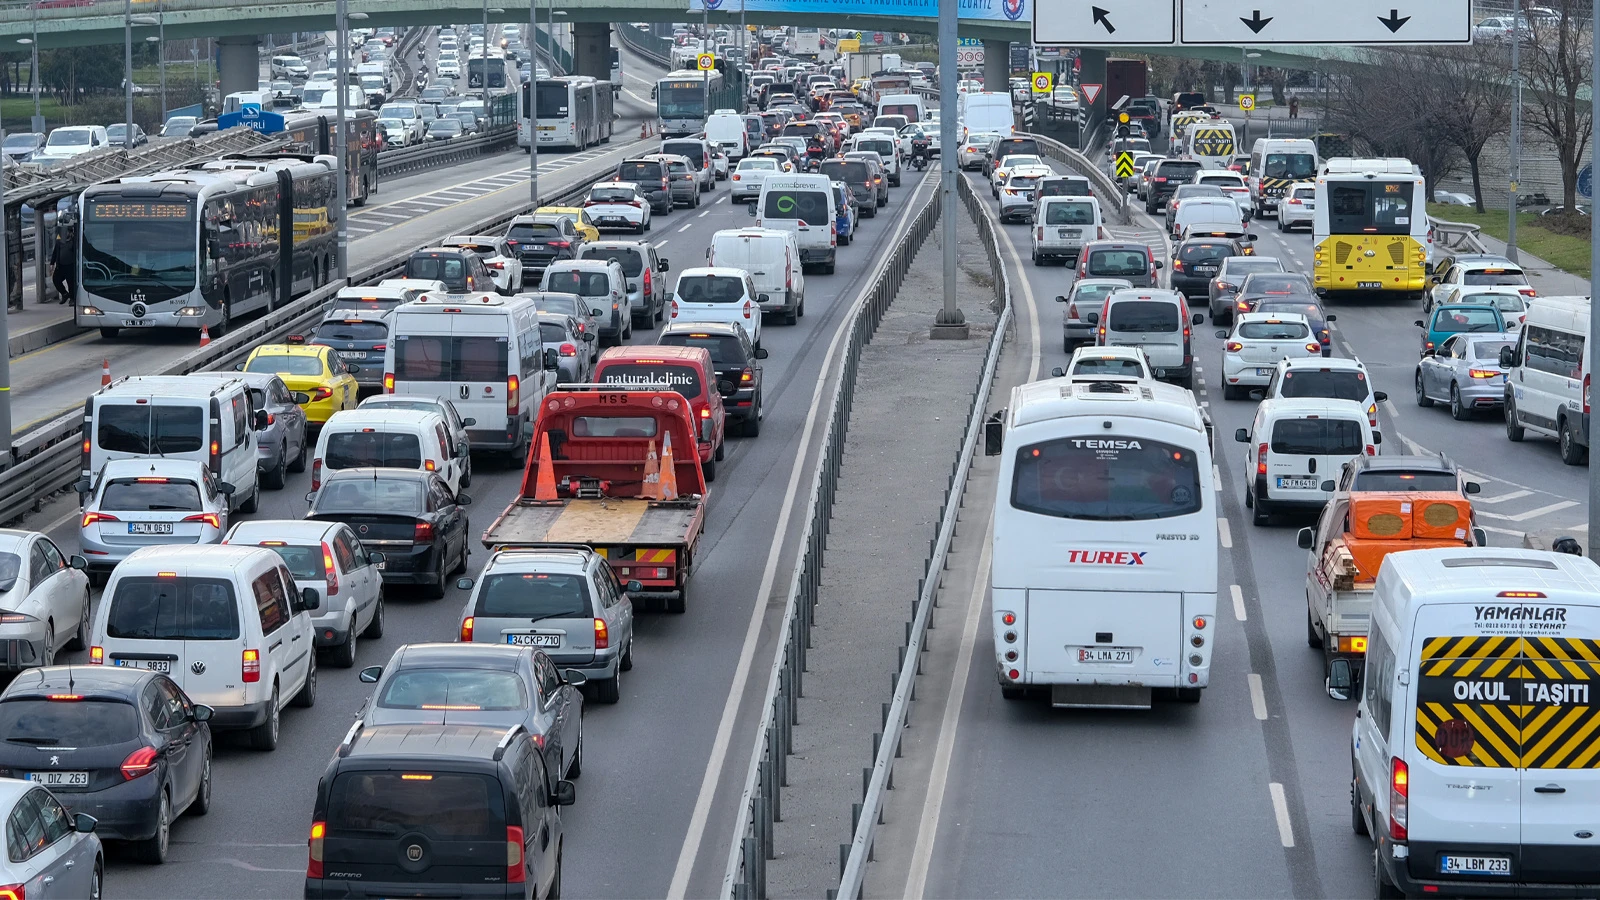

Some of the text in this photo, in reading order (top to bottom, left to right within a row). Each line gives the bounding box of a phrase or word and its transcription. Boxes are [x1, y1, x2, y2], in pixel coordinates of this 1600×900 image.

[1071, 439, 1142, 450] TEMSA
[132, 523, 141, 531] 34
[144, 523, 152, 531] TN
[1068, 550, 1148, 565] TUREX
[1474, 606, 1567, 622] YAMANLAR
[1529, 622, 1567, 630] SEYAHAT
[512, 636, 559, 645] 34 CKP 710
[1084, 652, 1130, 660] 34 LMA 271
[147, 661, 168, 671] 9833
[1453, 680, 1589, 706] OKUL TAŞITI
[31, 773, 87, 784] 34 DIZ 263
[1447, 857, 1508, 871] 34 LBM 233
